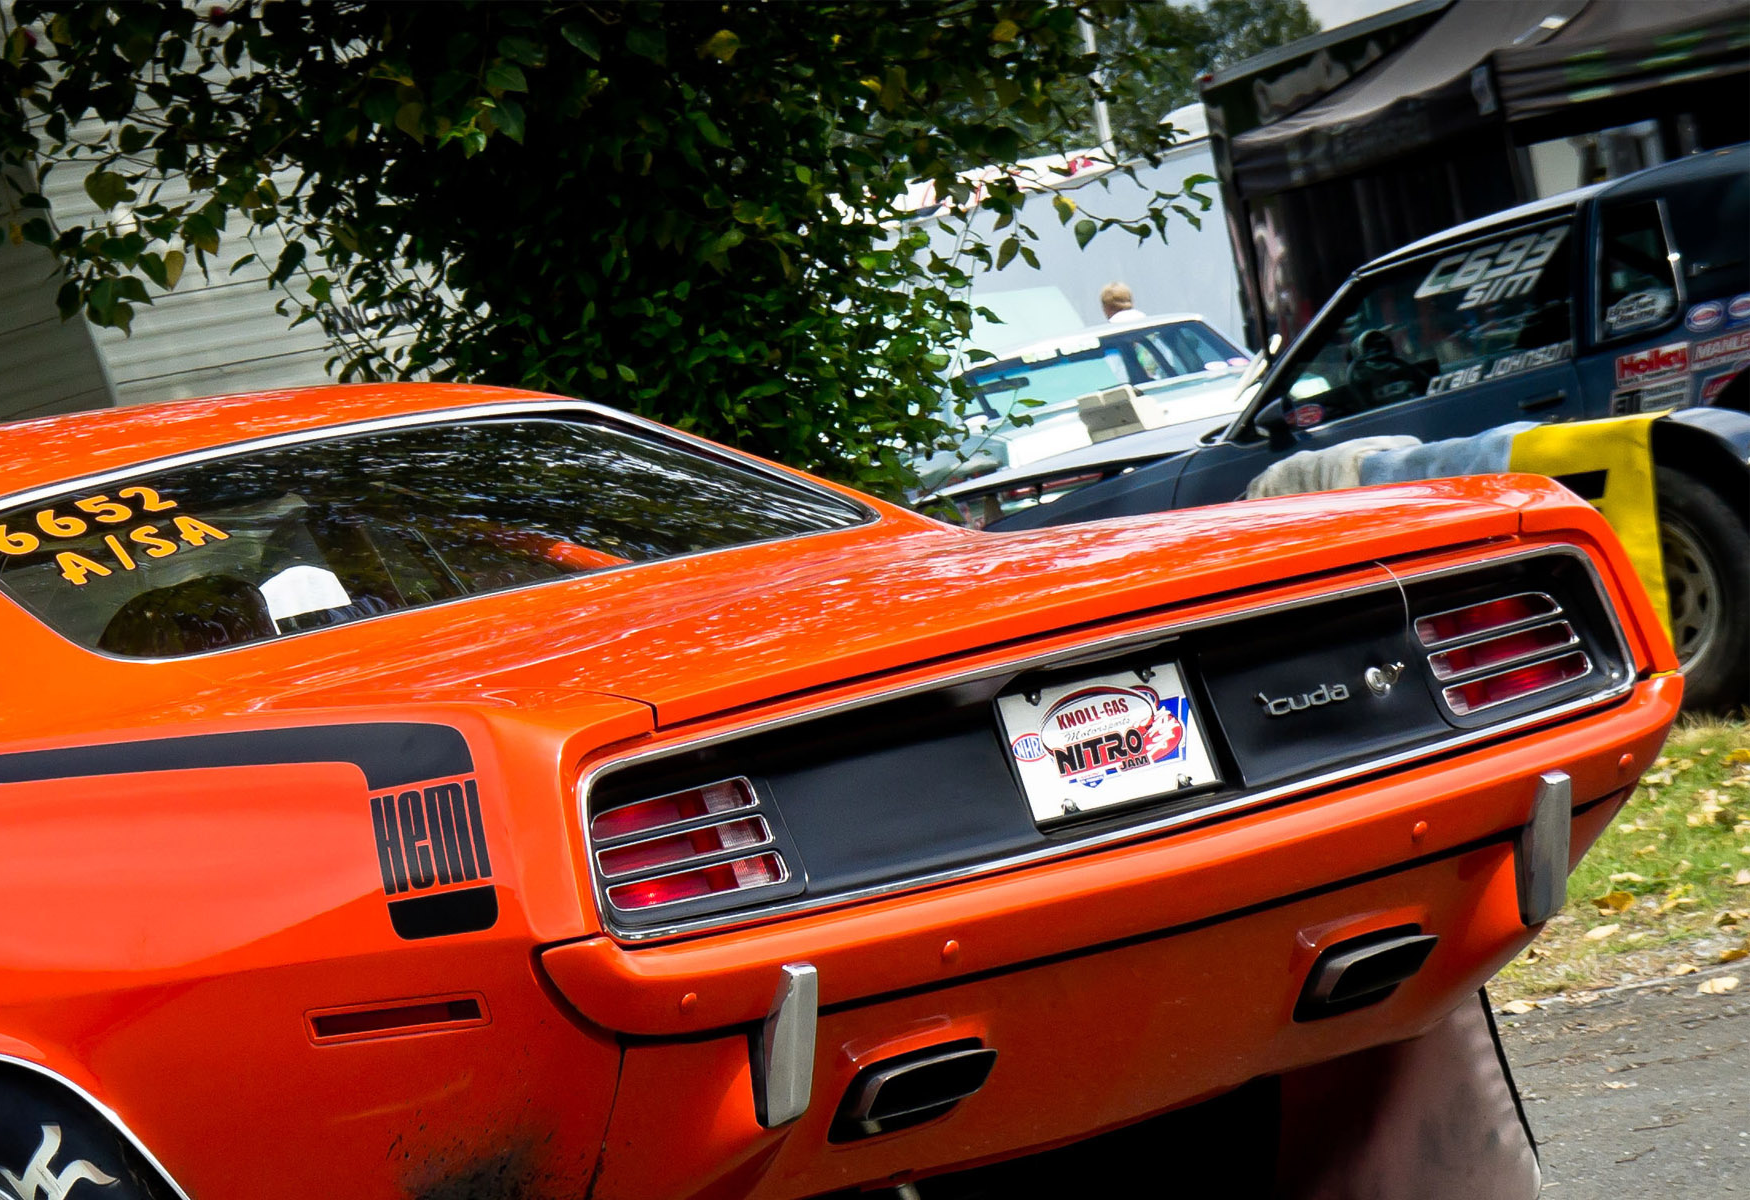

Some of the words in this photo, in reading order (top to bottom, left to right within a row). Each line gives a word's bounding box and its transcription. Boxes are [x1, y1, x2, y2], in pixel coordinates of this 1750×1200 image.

[1414, 224, 1571, 299] C693
[1617, 346, 1688, 380] Holley
[55, 515, 231, 586] A/SA
[1056, 697, 1129, 731] KNOLL-GAS
[1064, 717, 1131, 743] Motorsports
[1053, 728, 1144, 775] NITRO
[1120, 754, 1150, 771] JAM
